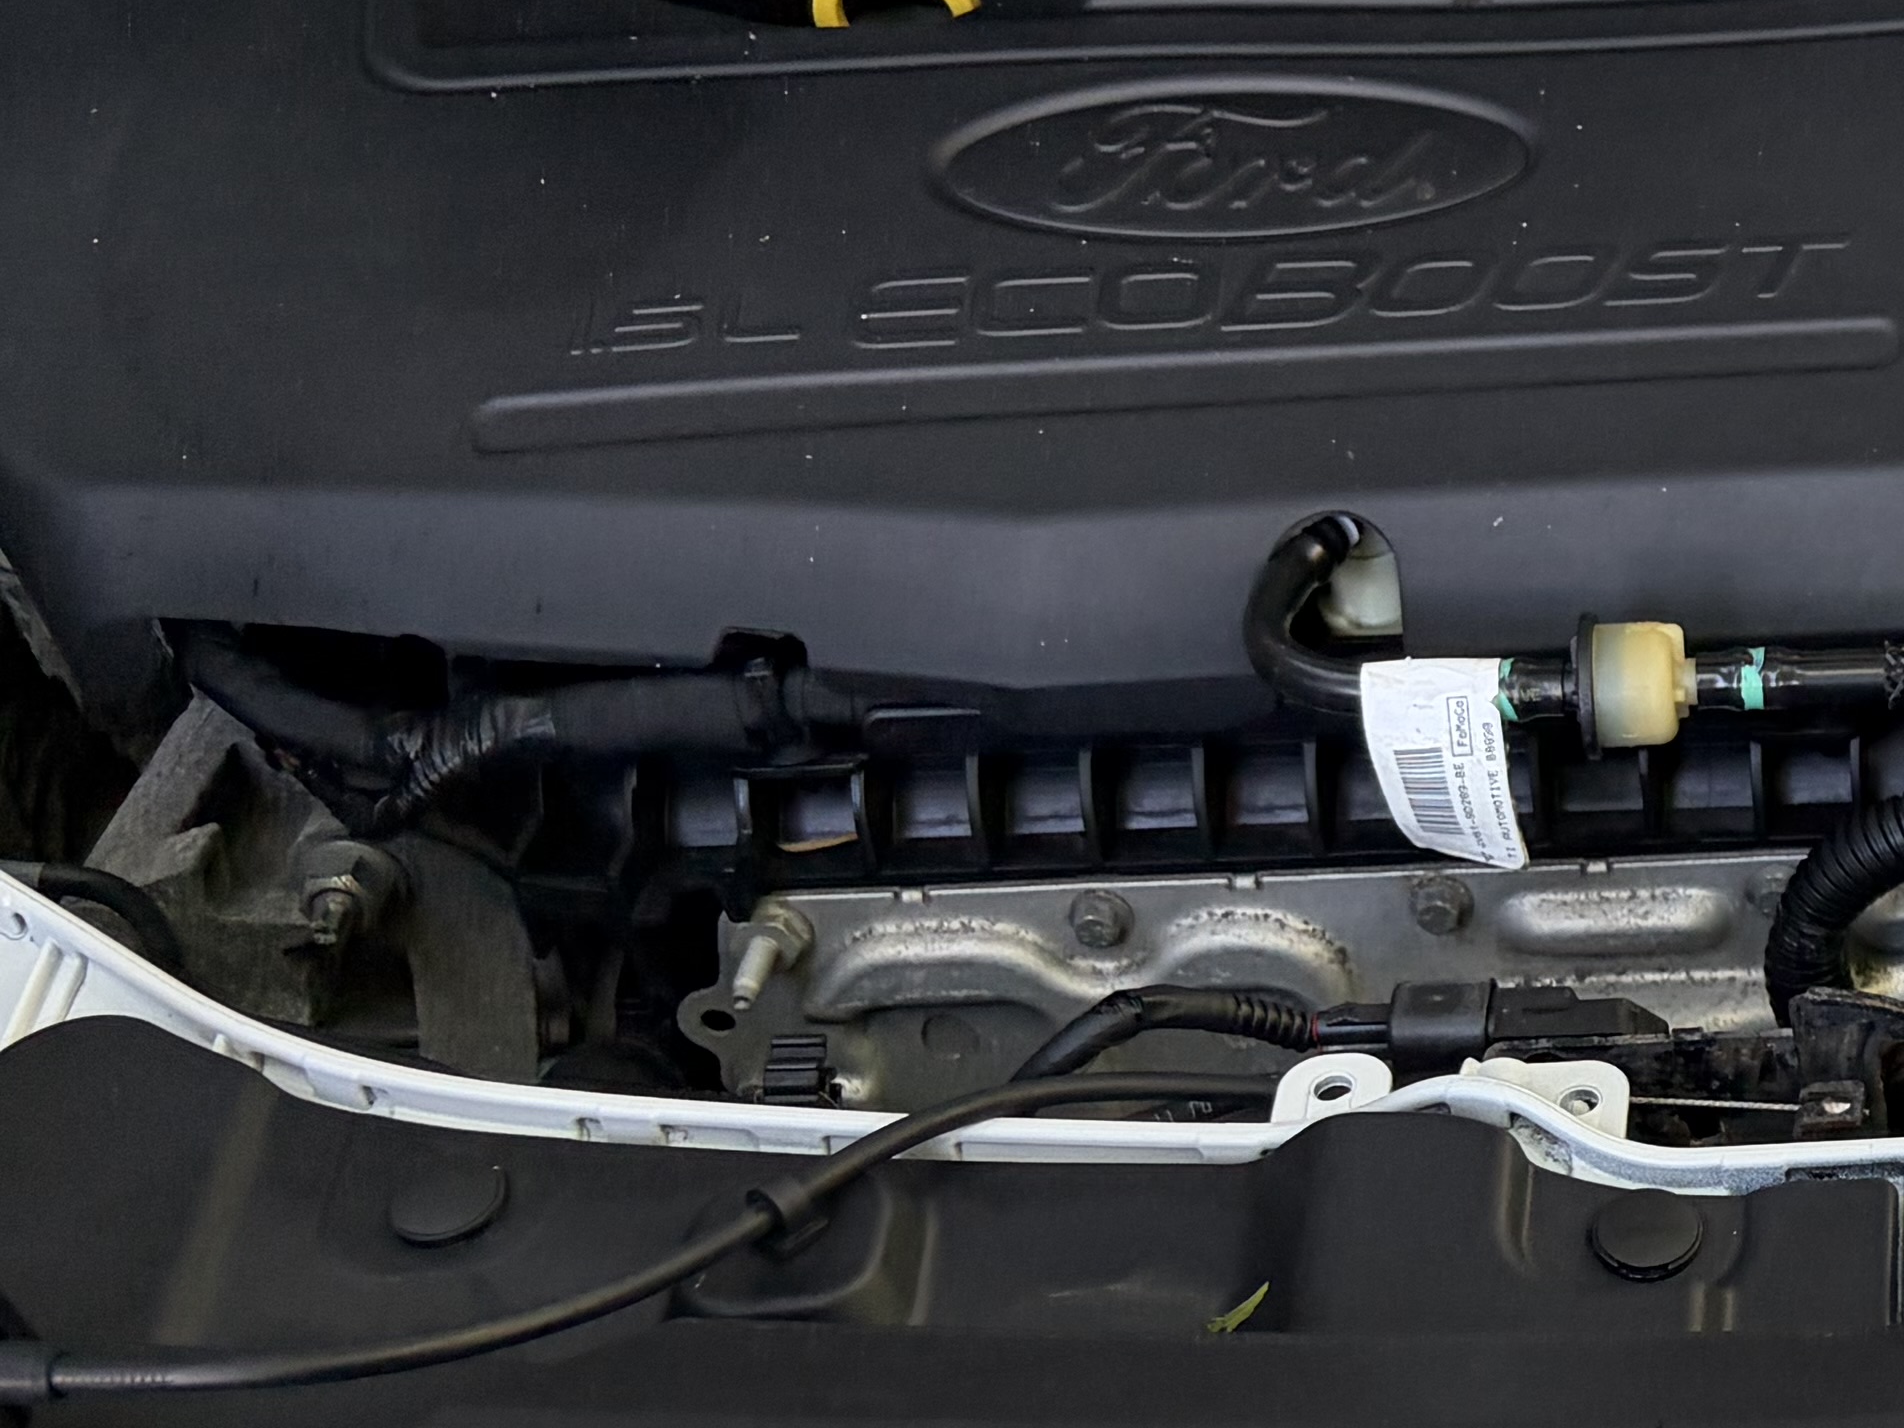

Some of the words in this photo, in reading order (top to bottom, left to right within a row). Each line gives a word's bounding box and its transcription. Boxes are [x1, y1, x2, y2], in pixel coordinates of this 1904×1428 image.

[1048, 104, 1434, 212] Ford
[851, 239, 1850, 349] ECOBOOST
[1454, 700, 1468, 748] FoMoCo
[1487, 770, 1512, 841] AUTOMOTIVE
